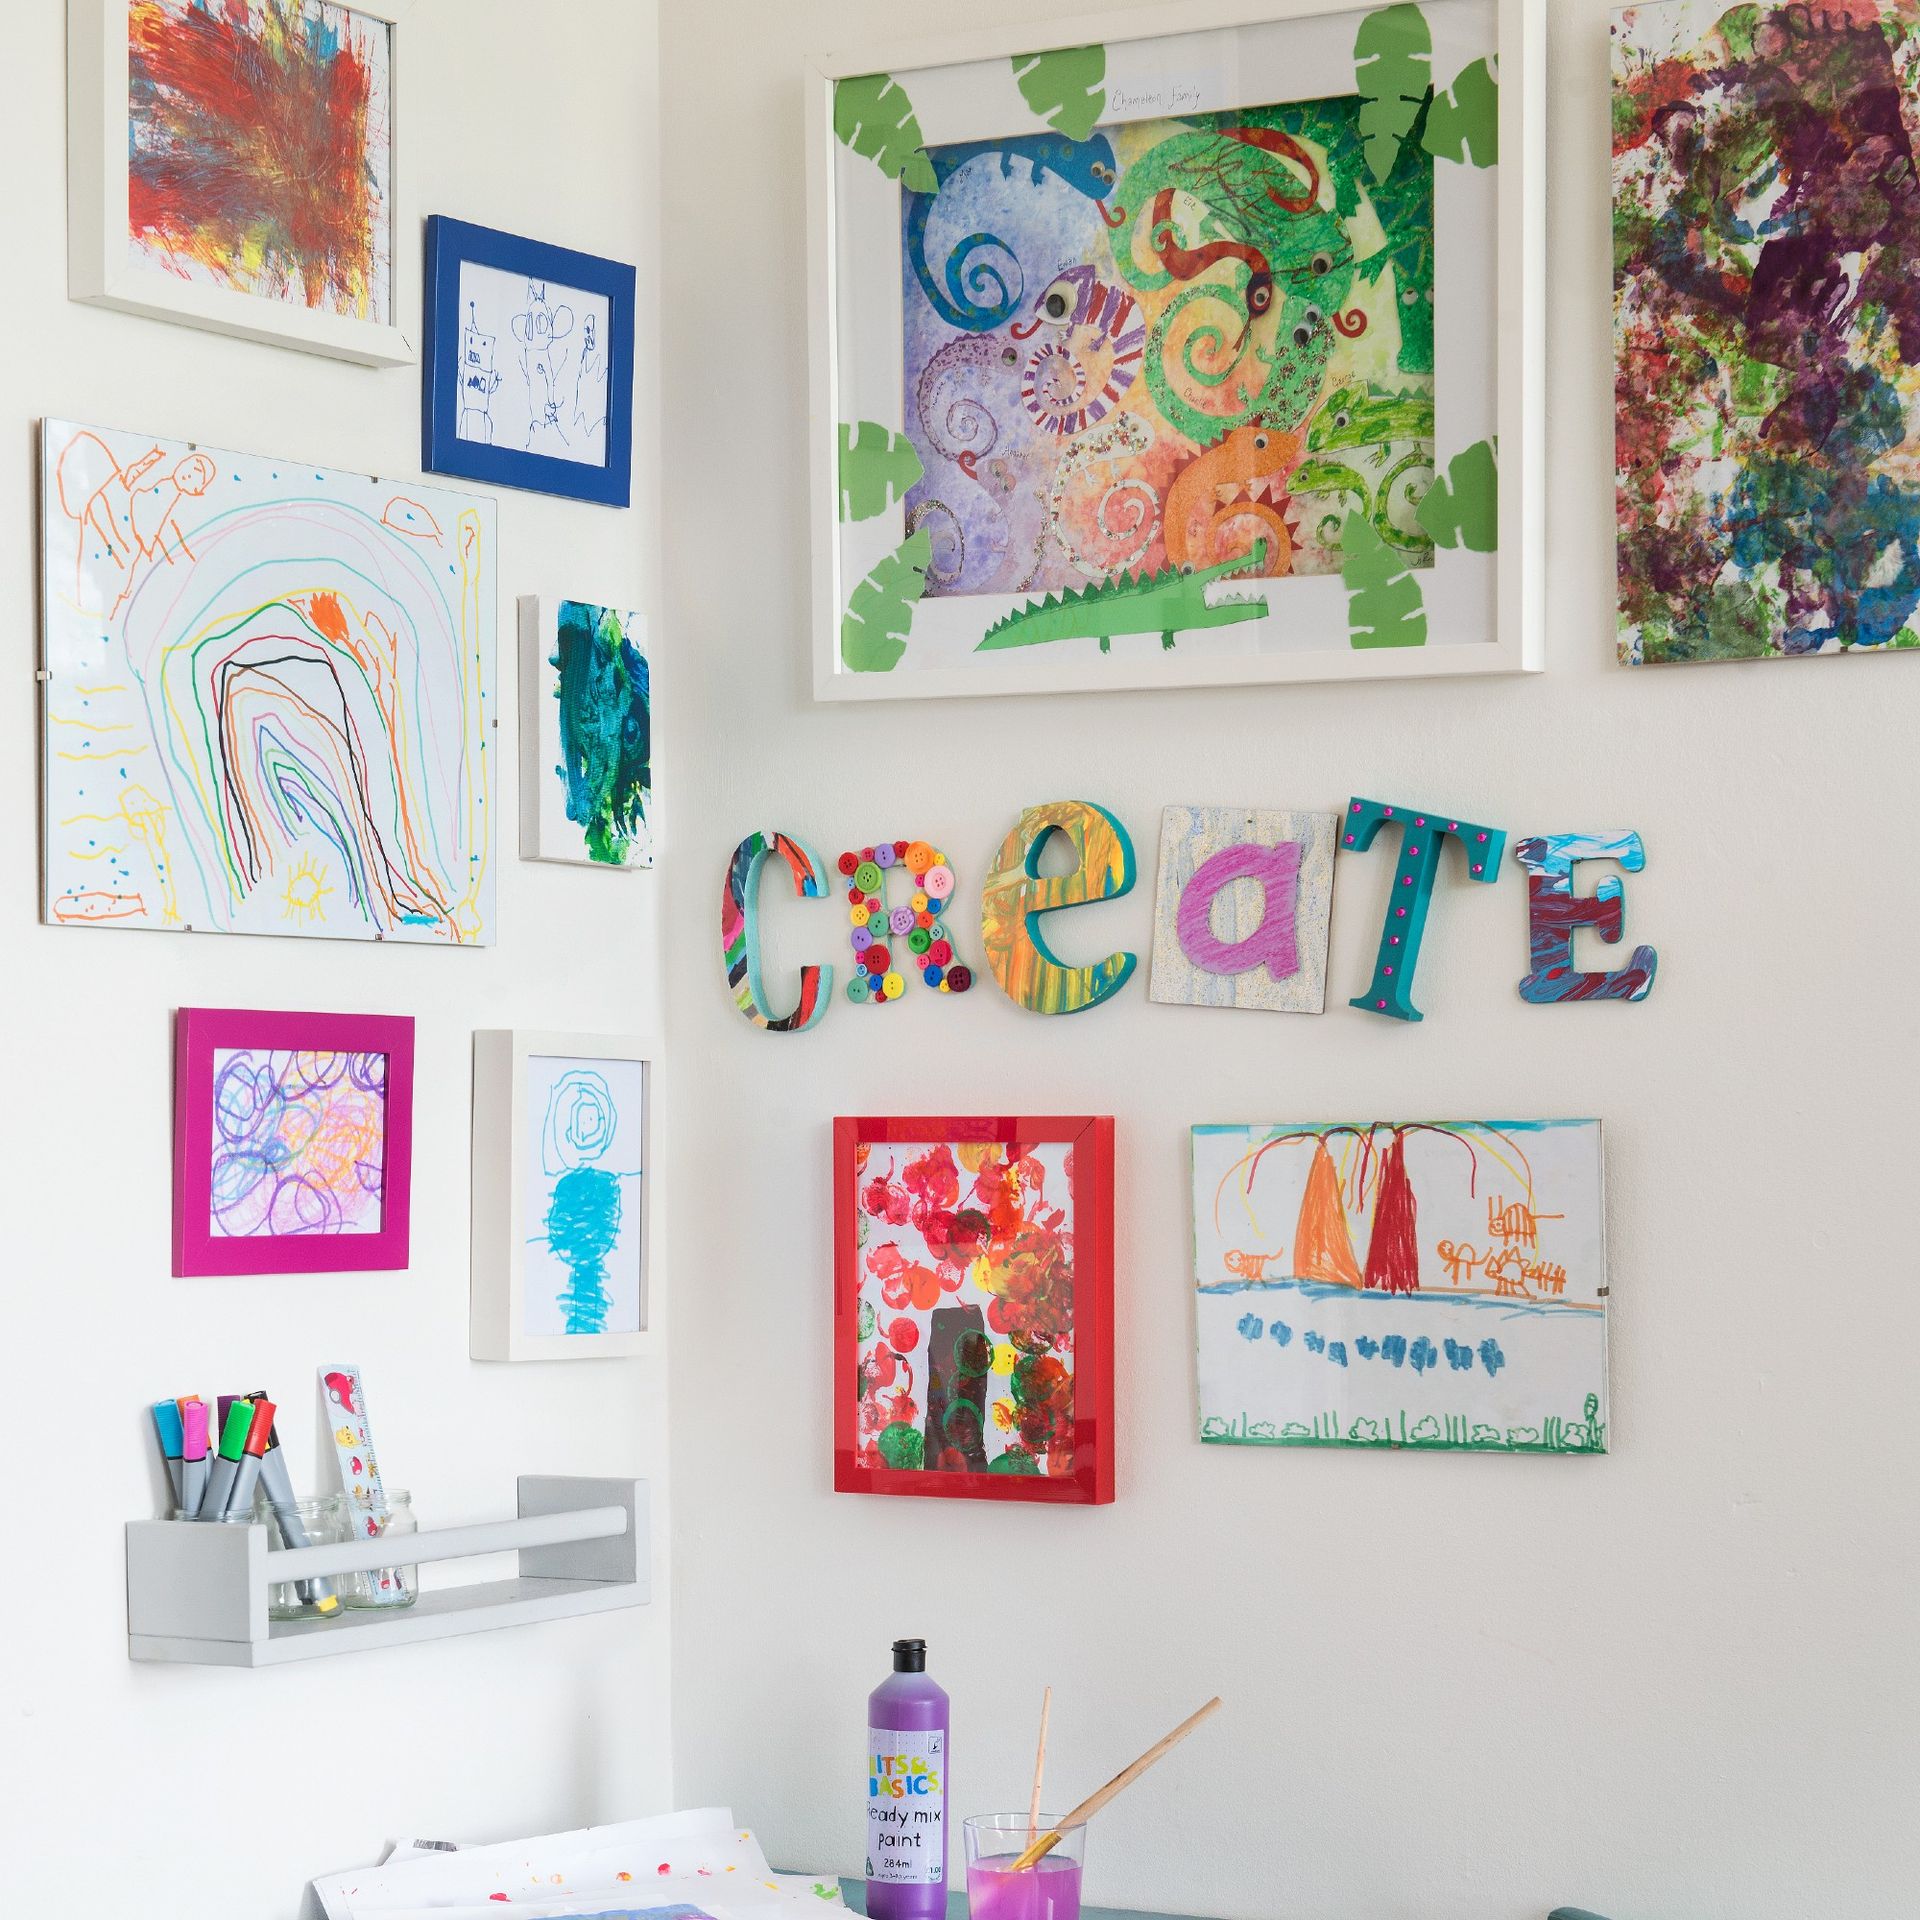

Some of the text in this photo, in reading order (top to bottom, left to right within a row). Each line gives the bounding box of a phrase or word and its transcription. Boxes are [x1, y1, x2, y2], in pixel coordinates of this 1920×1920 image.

[914, 1806, 941, 1823] mix
[878, 1830, 921, 1851] paint
[883, 1857, 912, 1869] 284ml
